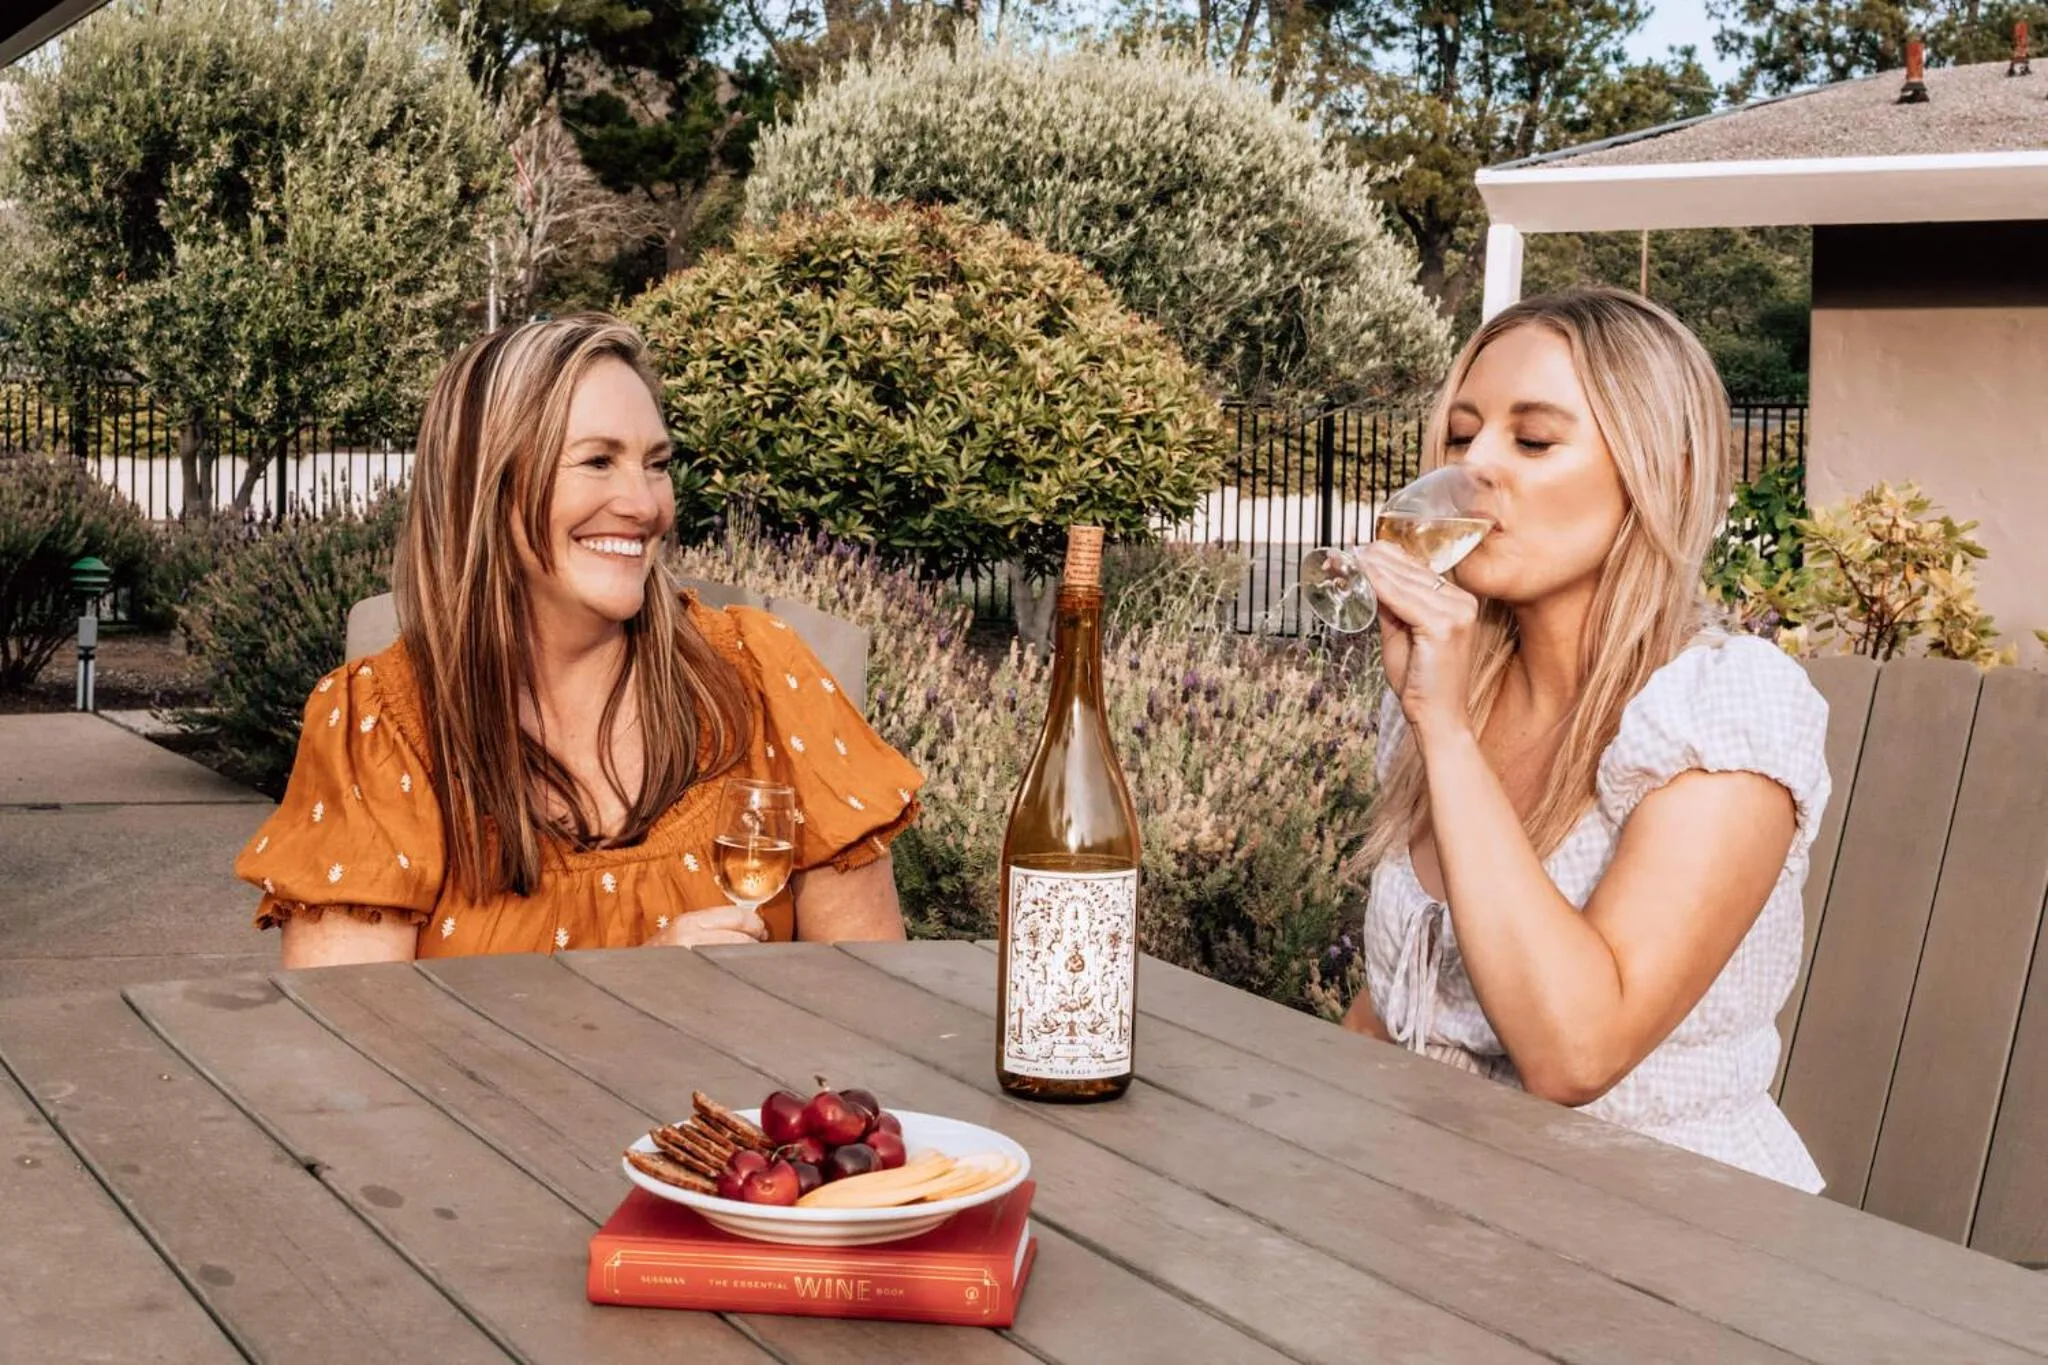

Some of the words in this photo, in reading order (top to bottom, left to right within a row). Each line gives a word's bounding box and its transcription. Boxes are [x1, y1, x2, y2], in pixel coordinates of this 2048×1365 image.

[709, 1279, 729, 1288] THE
[733, 1279, 788, 1290] ESSENTIAL
[794, 1276, 872, 1300] WINE
[876, 1287, 905, 1298] BOOK
